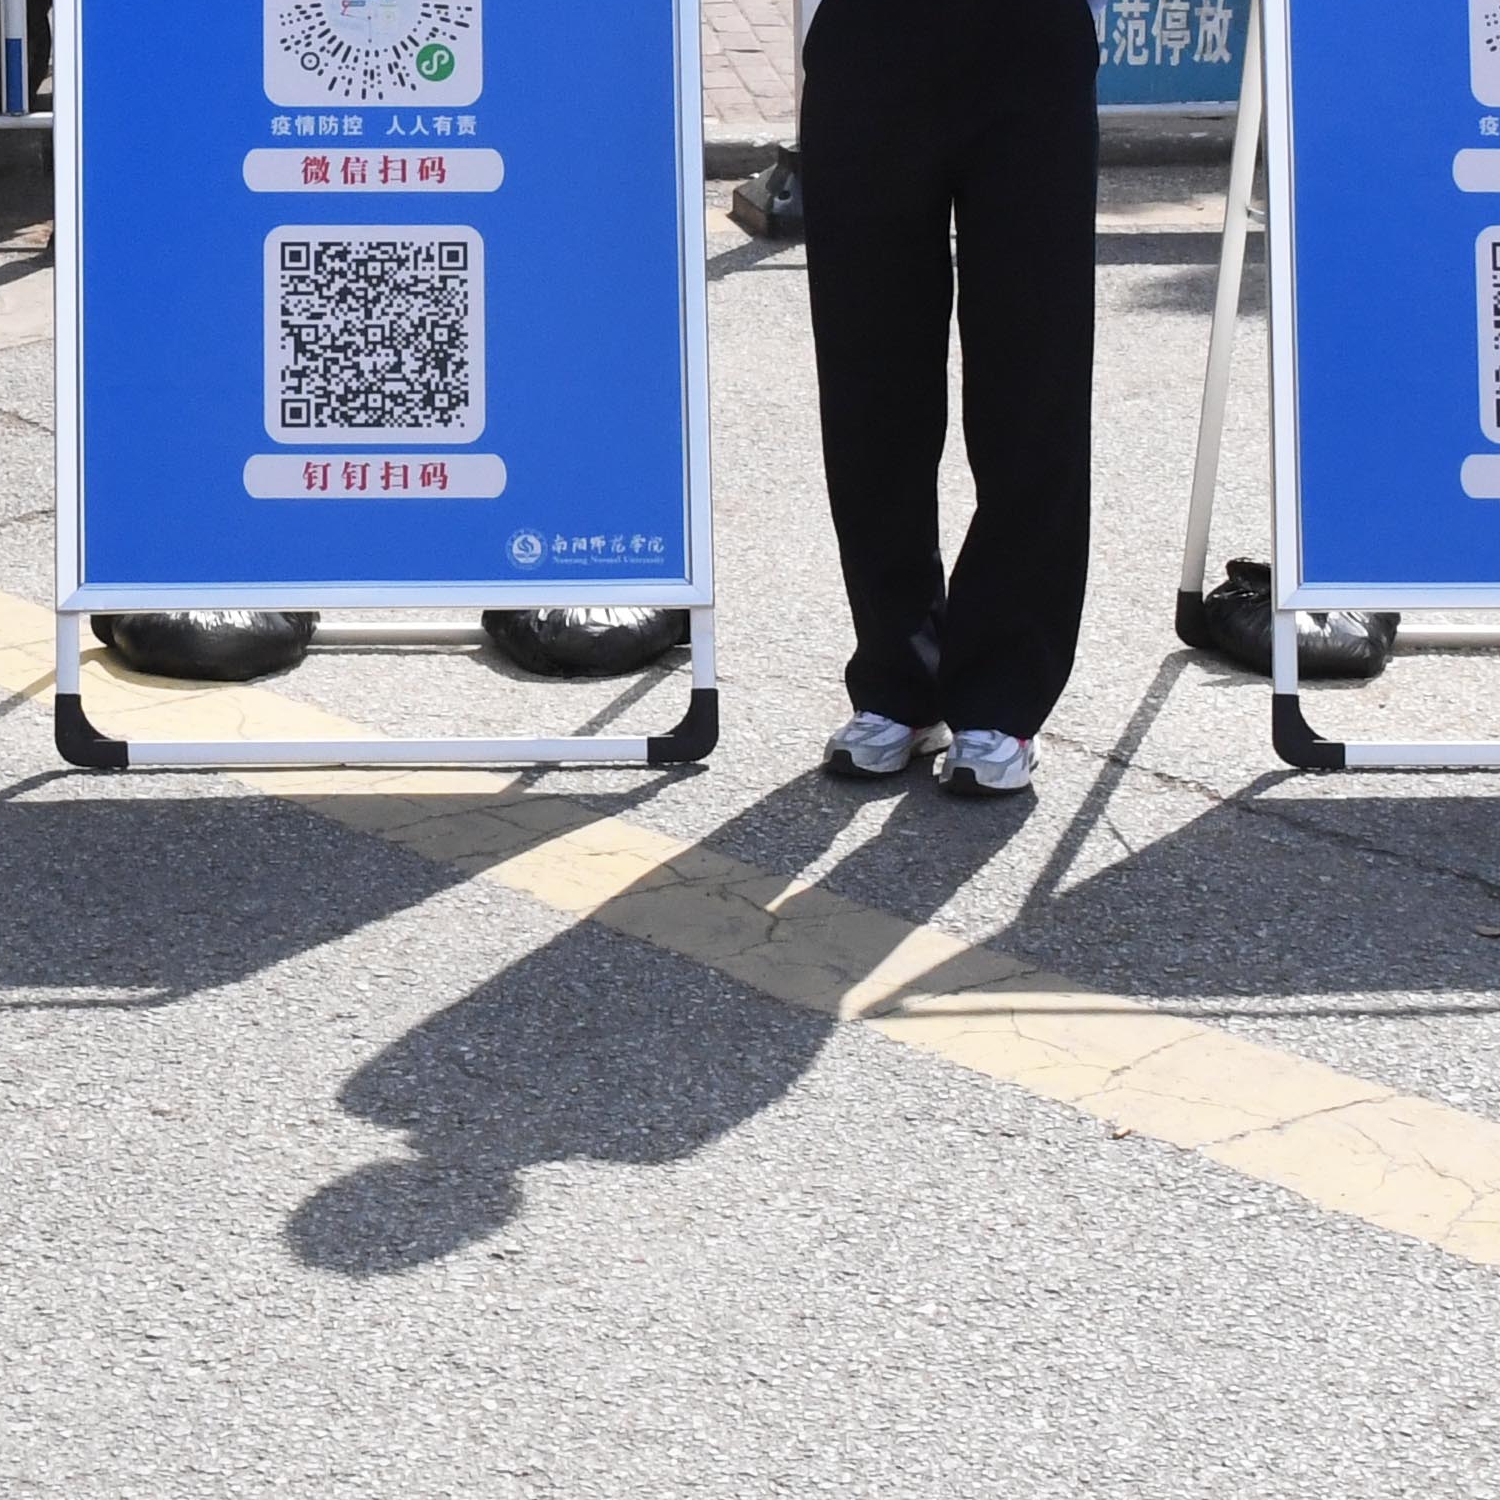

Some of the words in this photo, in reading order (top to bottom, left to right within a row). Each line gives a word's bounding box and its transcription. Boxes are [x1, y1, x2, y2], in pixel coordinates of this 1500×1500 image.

[272, 115, 362, 135] 疫情防控
[387, 116, 476, 135] 人人有责
[301, 156, 446, 184] 微信扫码
[302, 462, 448, 490] 钉钉扫码
[552, 533, 664, 553] 南阳师范学院
